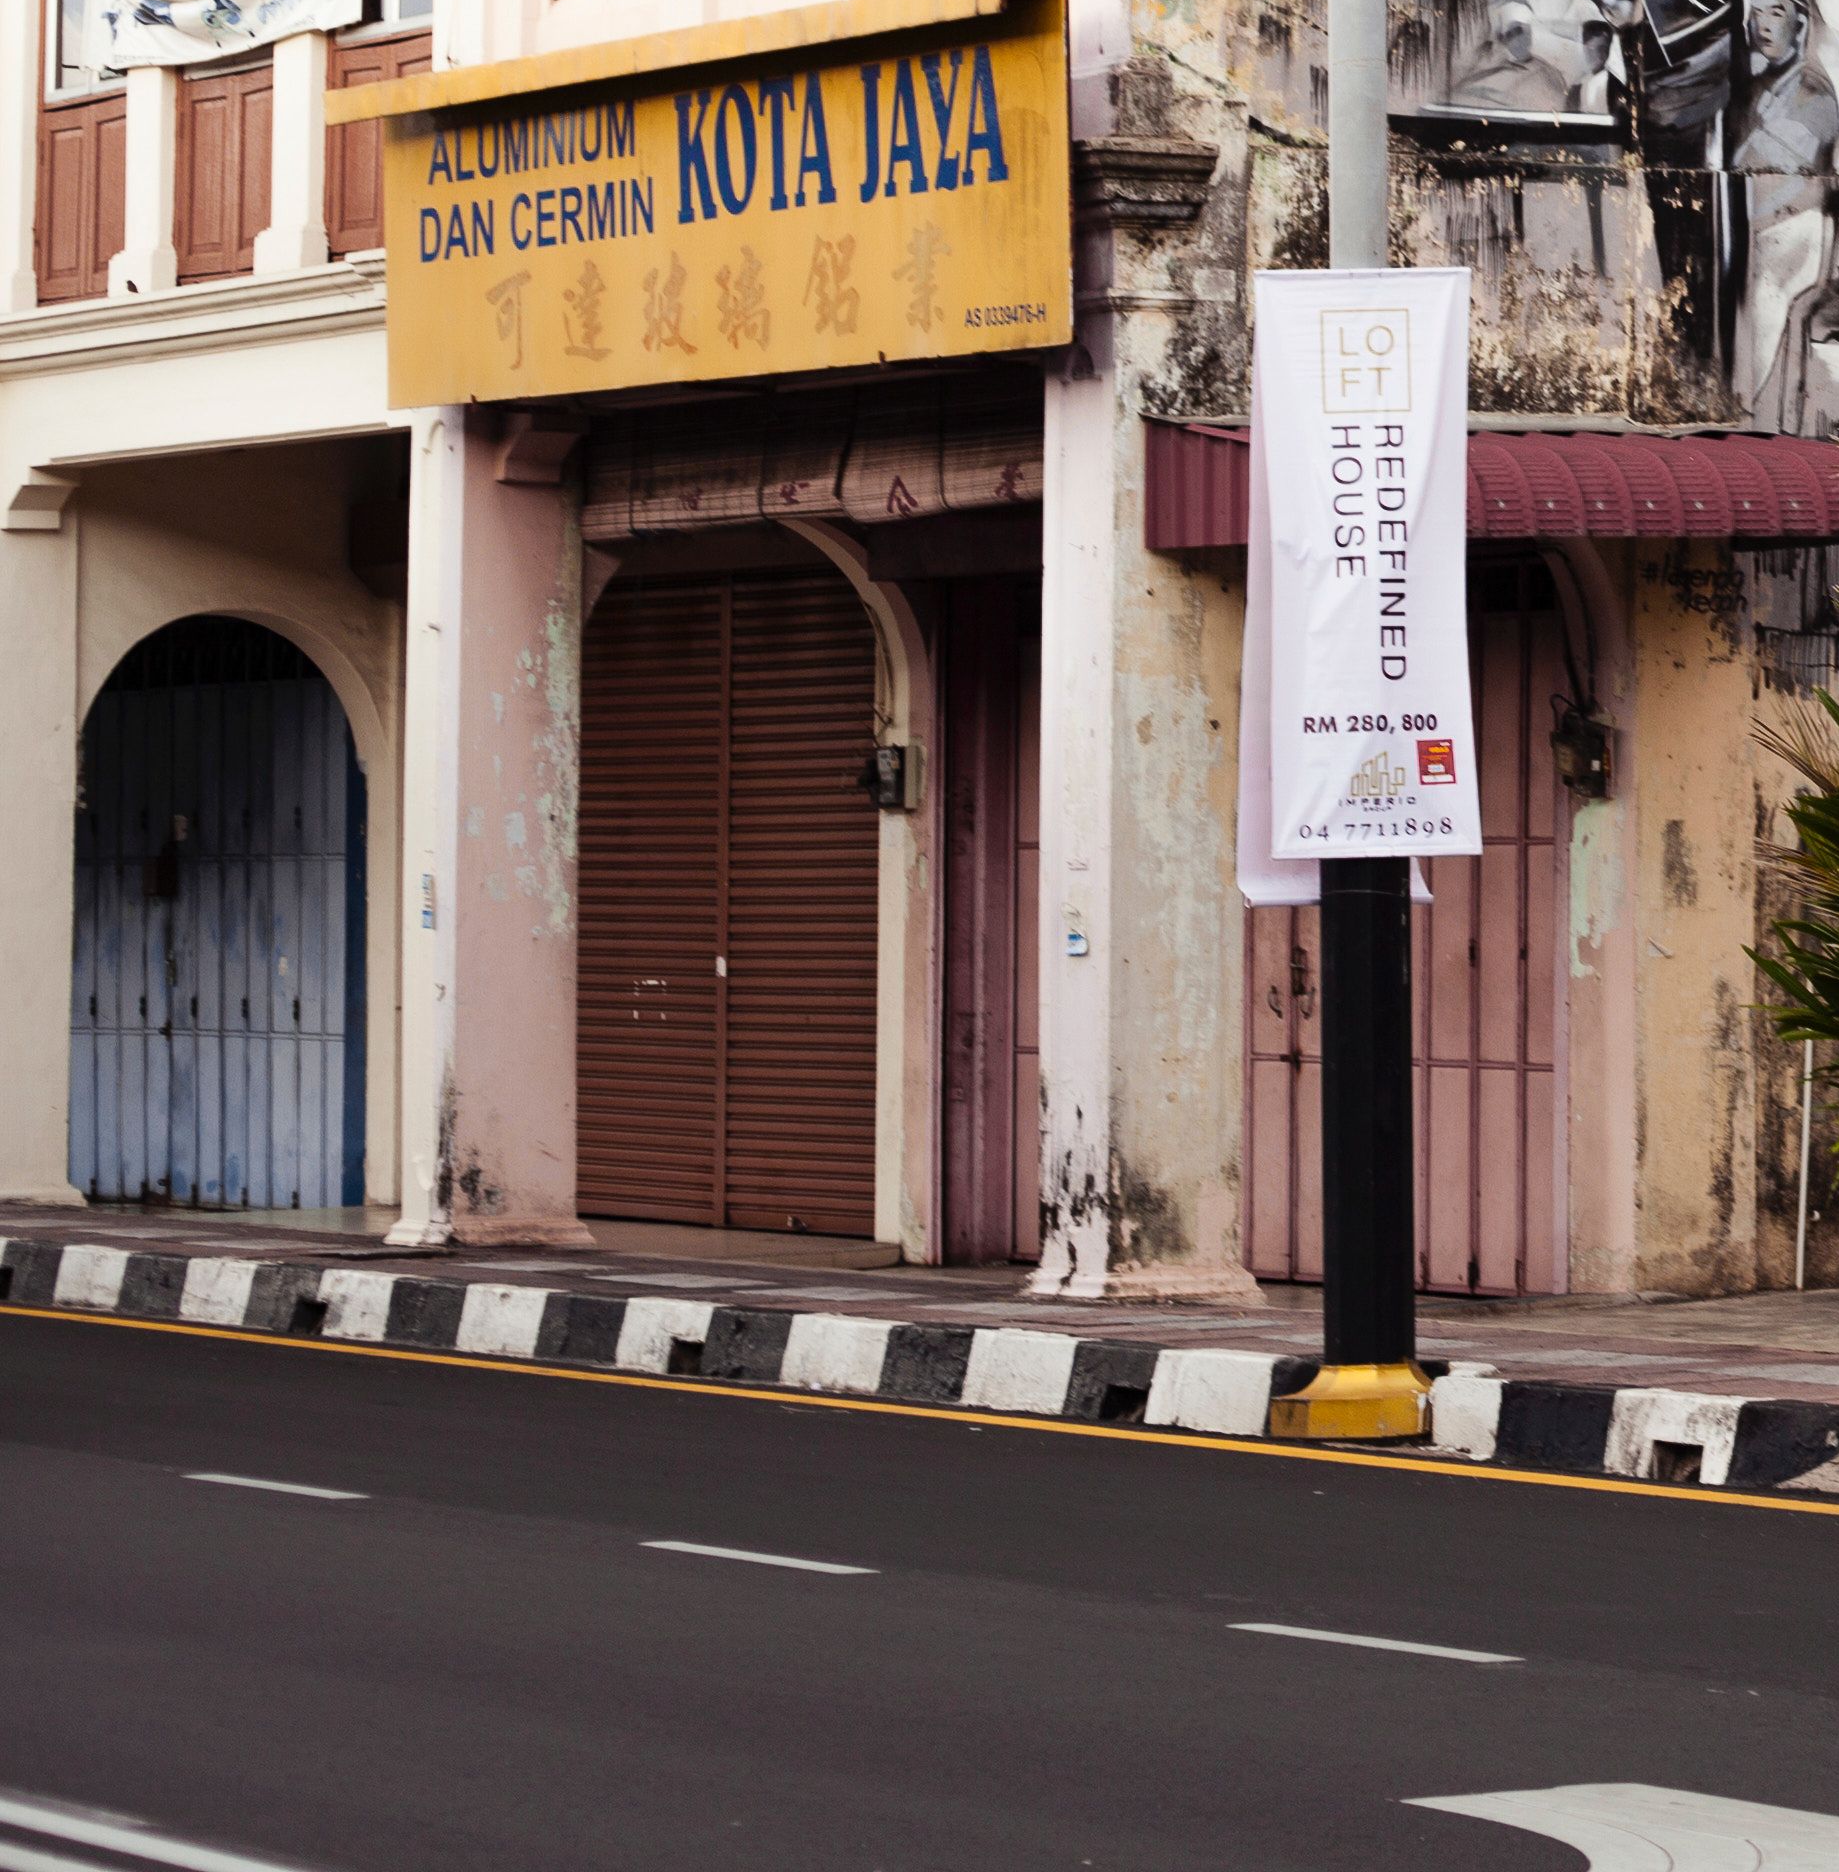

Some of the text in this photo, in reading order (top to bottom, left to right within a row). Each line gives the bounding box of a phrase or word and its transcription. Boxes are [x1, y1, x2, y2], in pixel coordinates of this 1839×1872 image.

[428, 45, 1009, 224] ALUMINIUM KOTA JAYA
[420, 177, 654, 262] DAN CERMIN
[1339, 326, 1395, 357] LO
[1341, 367, 1391, 397] FT
[1331, 426, 1366, 578] HOUSE
[1373, 426, 1408, 681] REDEFINED
[1303, 716, 1337, 733] RM
[1402, 714, 1438, 731] 800
[1299, 817, 1453, 841] 04 7711898
